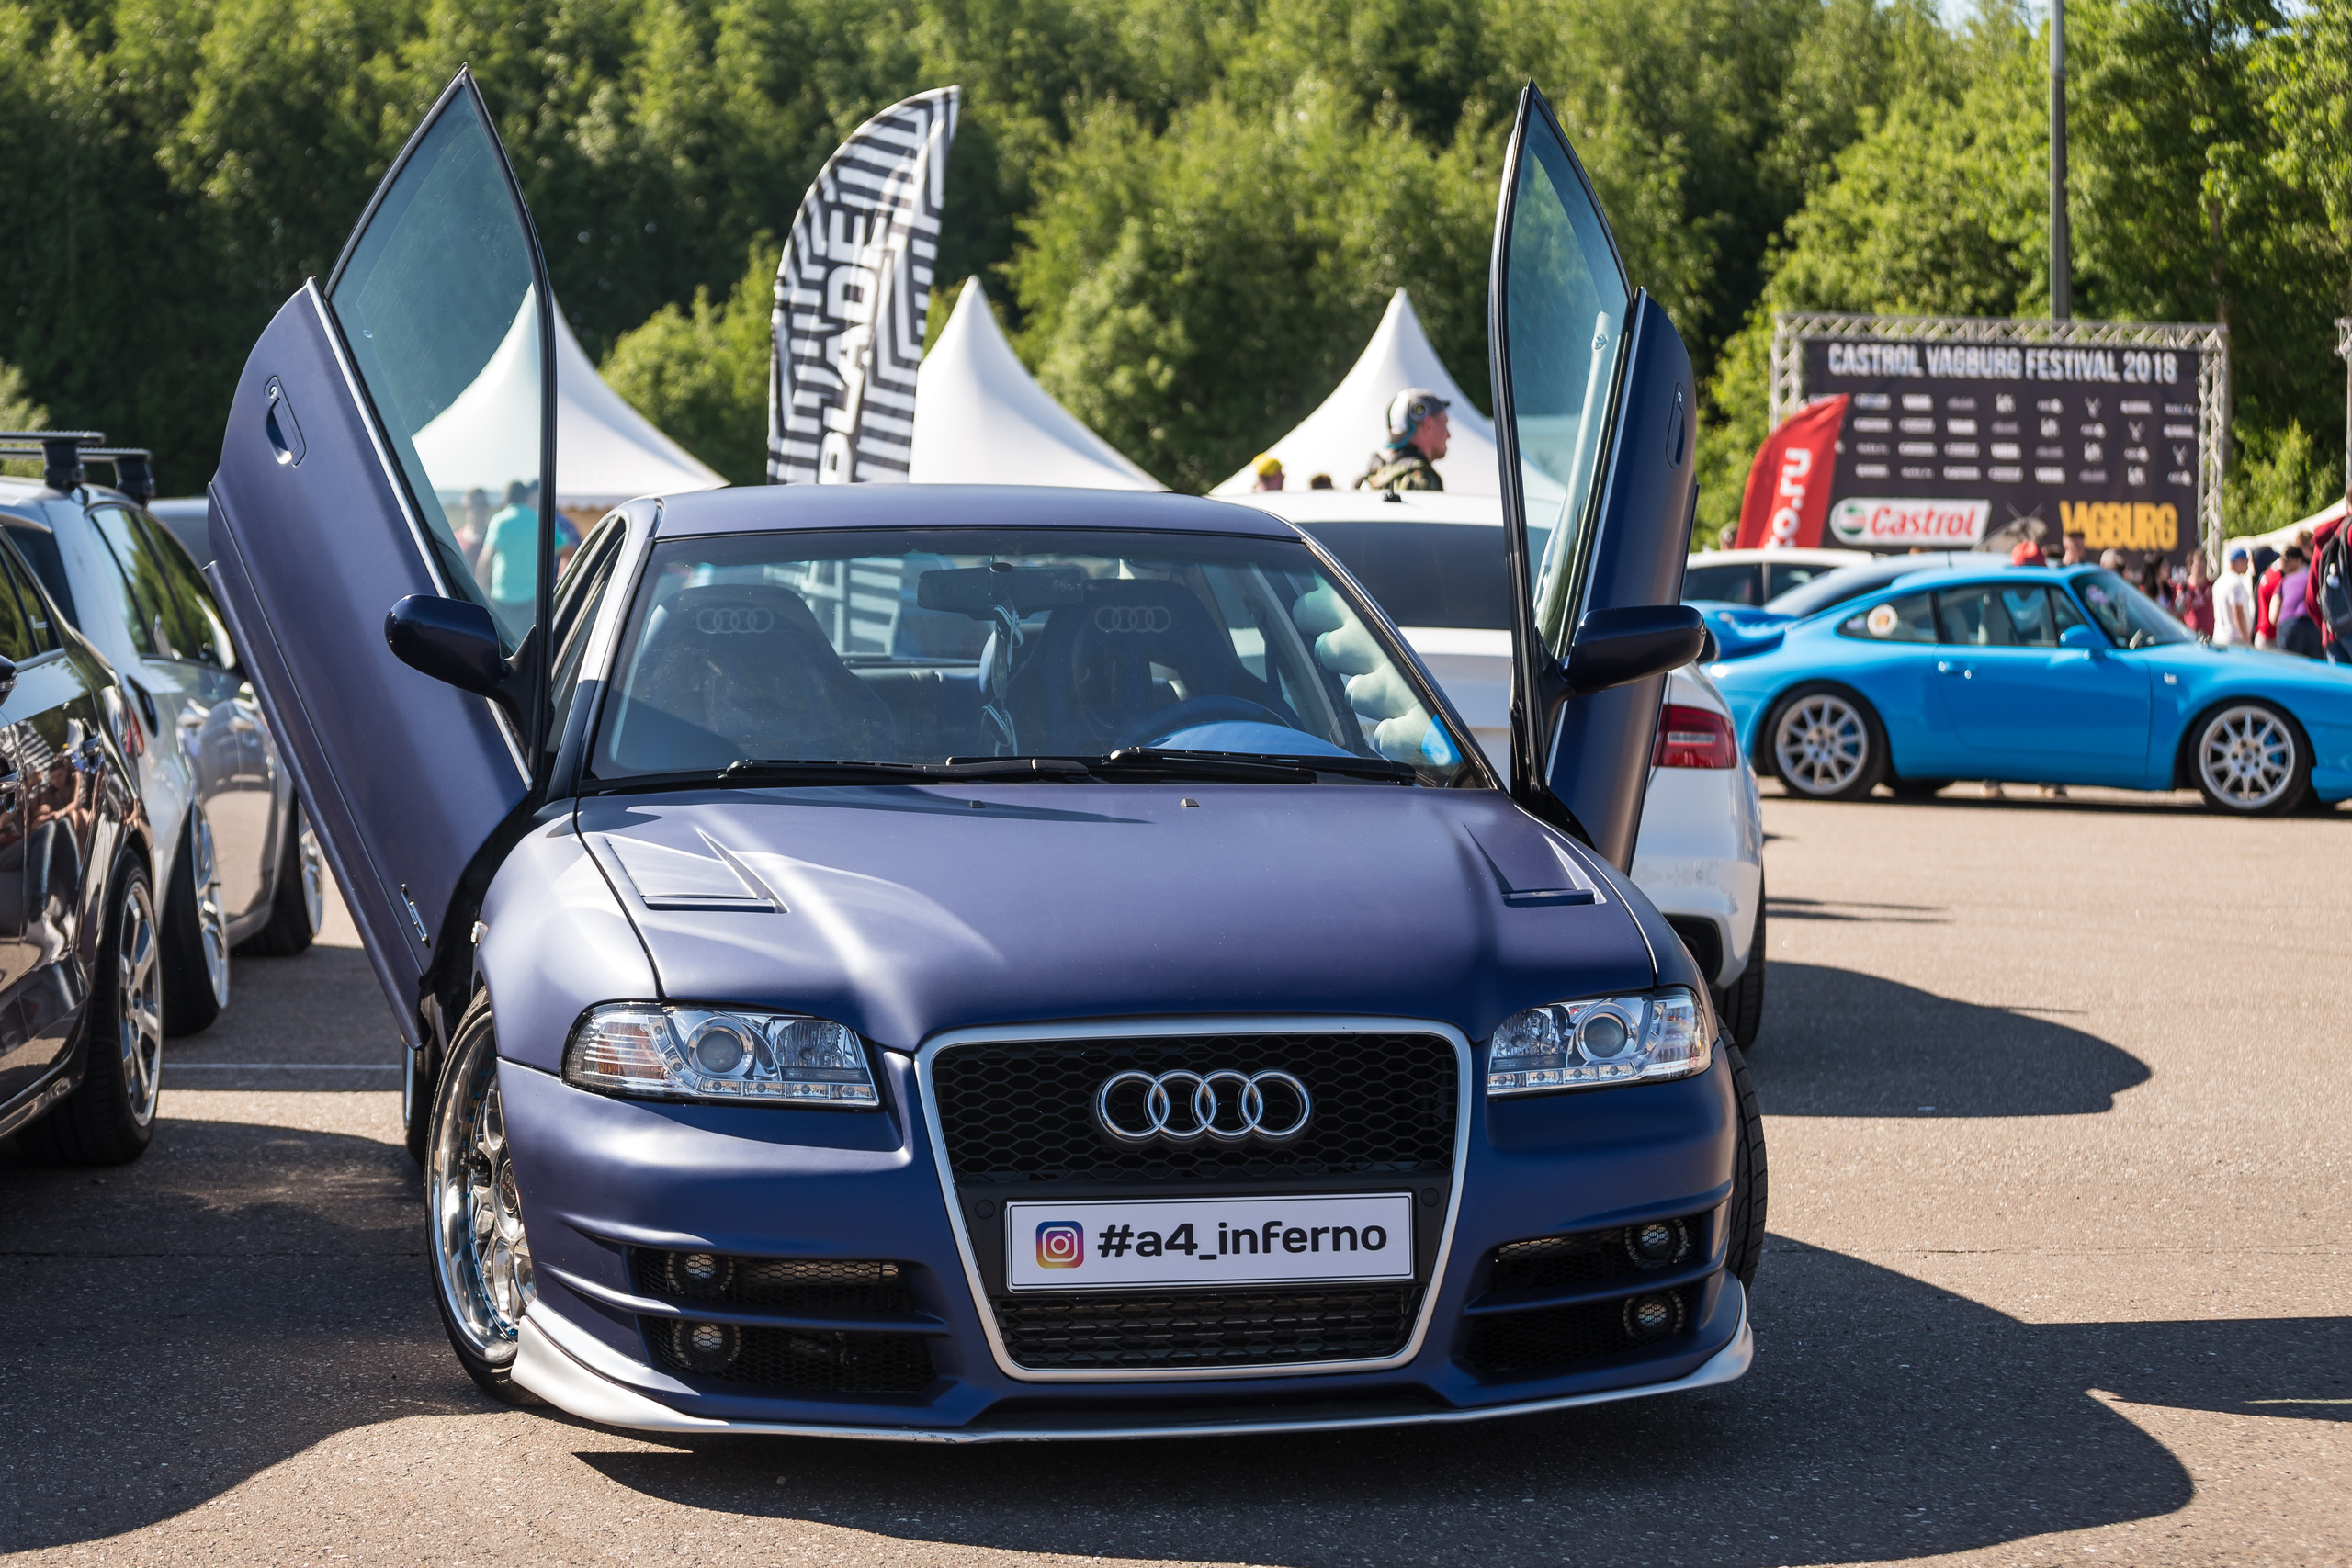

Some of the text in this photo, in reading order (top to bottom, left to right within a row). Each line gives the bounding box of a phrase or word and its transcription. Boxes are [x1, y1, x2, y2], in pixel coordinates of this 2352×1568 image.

[1827, 343, 2178, 384] CASTROL VAGBURG FESTIVAL 2018
[1871, 507, 1975, 536] Castrol
[2059, 500, 2178, 552] VAGBURG
[1097, 1220, 1388, 1261] #a4_inferno
